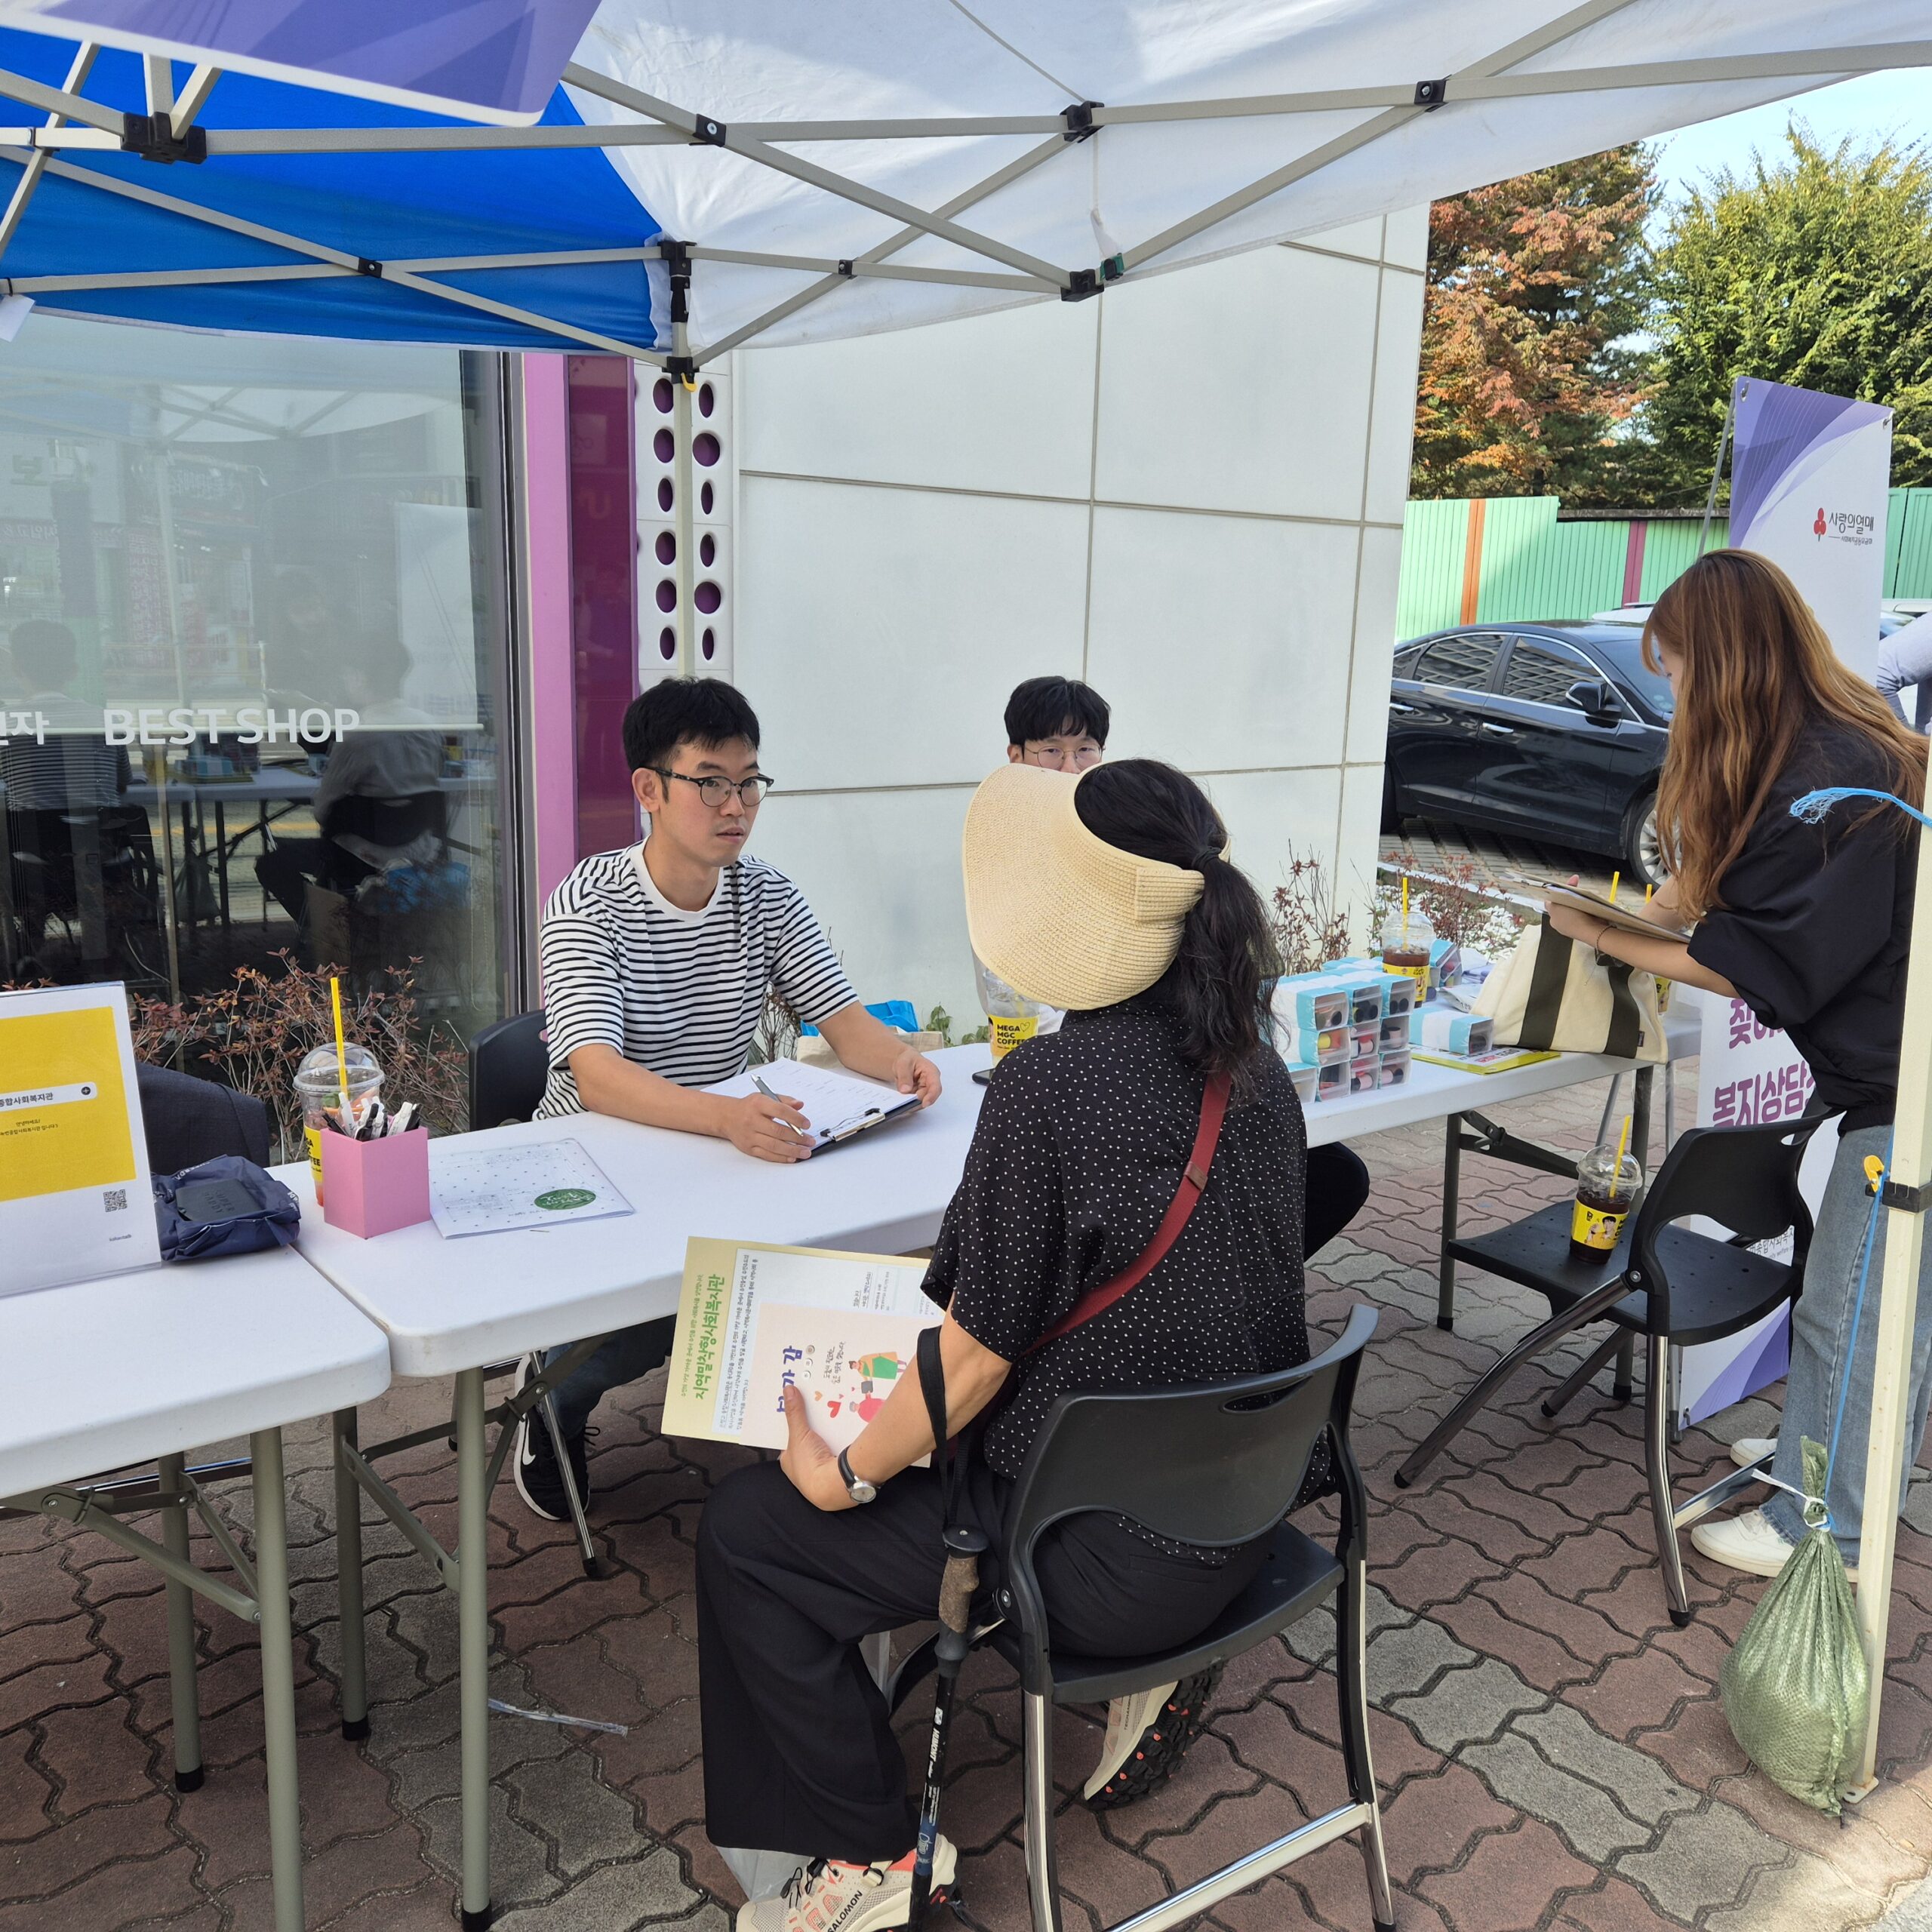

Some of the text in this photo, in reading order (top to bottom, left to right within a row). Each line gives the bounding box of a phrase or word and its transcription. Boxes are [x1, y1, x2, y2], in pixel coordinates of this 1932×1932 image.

[1829, 512, 1874, 534] 사랑의열매
[0, 707, 360, 746] 자 BEST SHOP
[691, 1274, 725, 1400] 지역밀착형사회복지관
[827, 1890, 863, 1932] SALOMON
